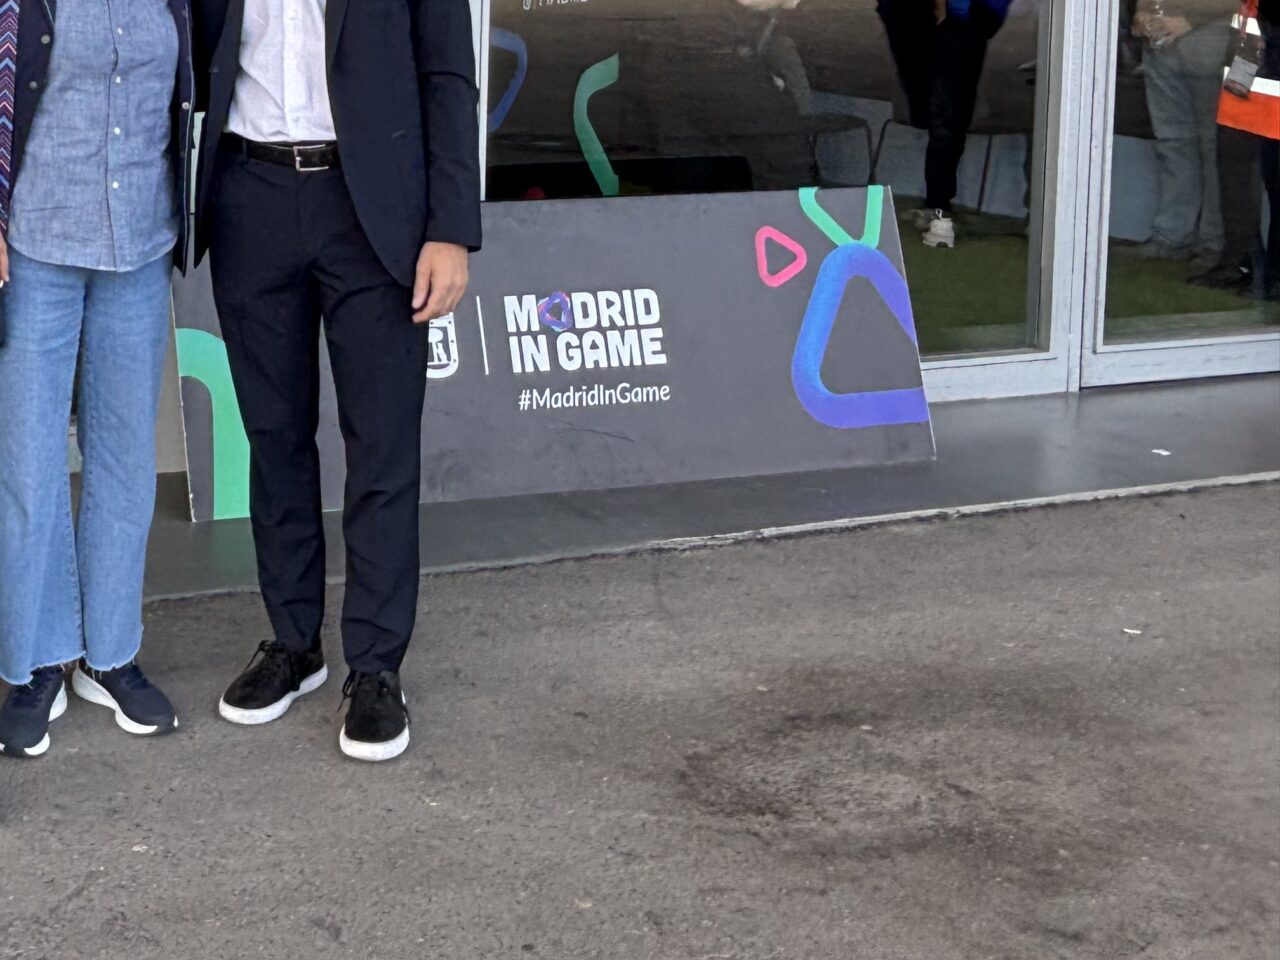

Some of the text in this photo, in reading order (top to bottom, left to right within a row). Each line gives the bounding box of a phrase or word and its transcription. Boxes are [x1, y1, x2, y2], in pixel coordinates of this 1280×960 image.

[509, 329, 667, 373] IN GAME
[519, 383, 671, 411] #MadridInGame
